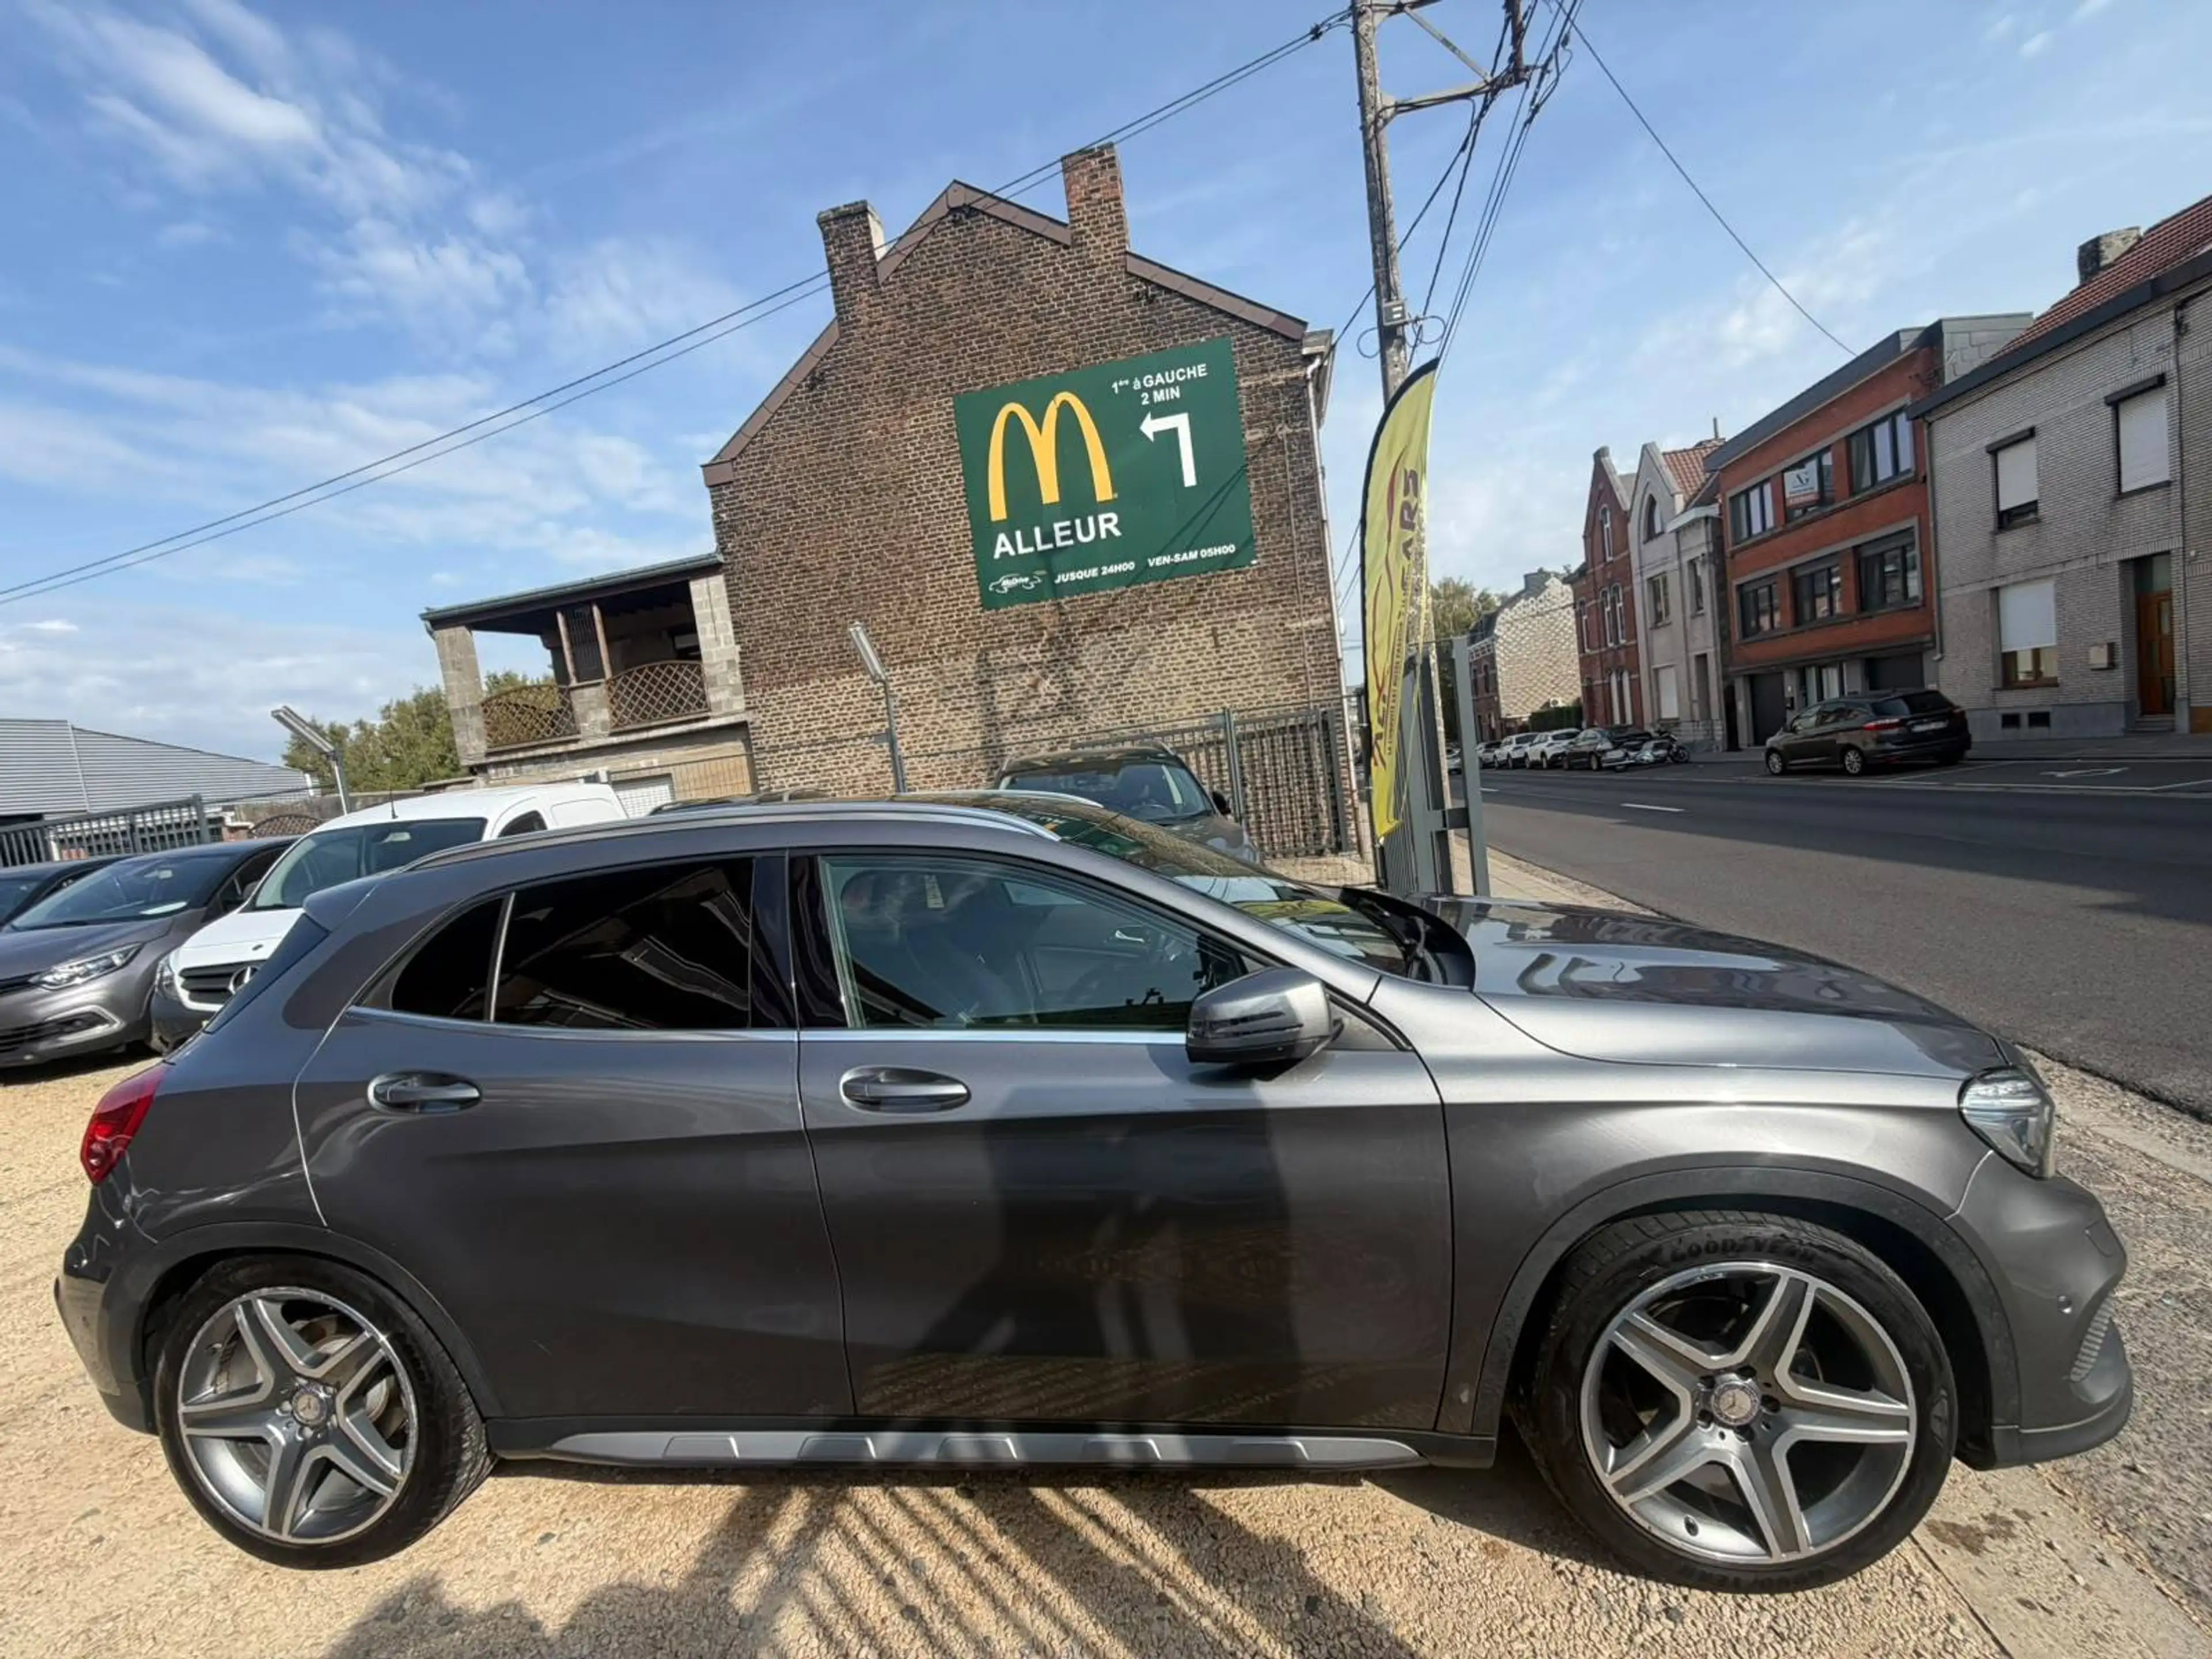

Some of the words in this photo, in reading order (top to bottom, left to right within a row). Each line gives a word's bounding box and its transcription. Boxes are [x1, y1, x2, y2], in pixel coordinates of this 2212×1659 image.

[1143, 363, 1208, 388] GAUCHE
[1141, 393, 1149, 405] 2
[1153, 386, 1180, 403] MIN
[993, 512, 1122, 559] ALLEUR
[1055, 567, 1099, 584] JUSQUE
[1101, 561, 1135, 575] 24H00
[1147, 550, 1198, 567] VEN-SAM
[1199, 544, 1236, 559] 05H00
